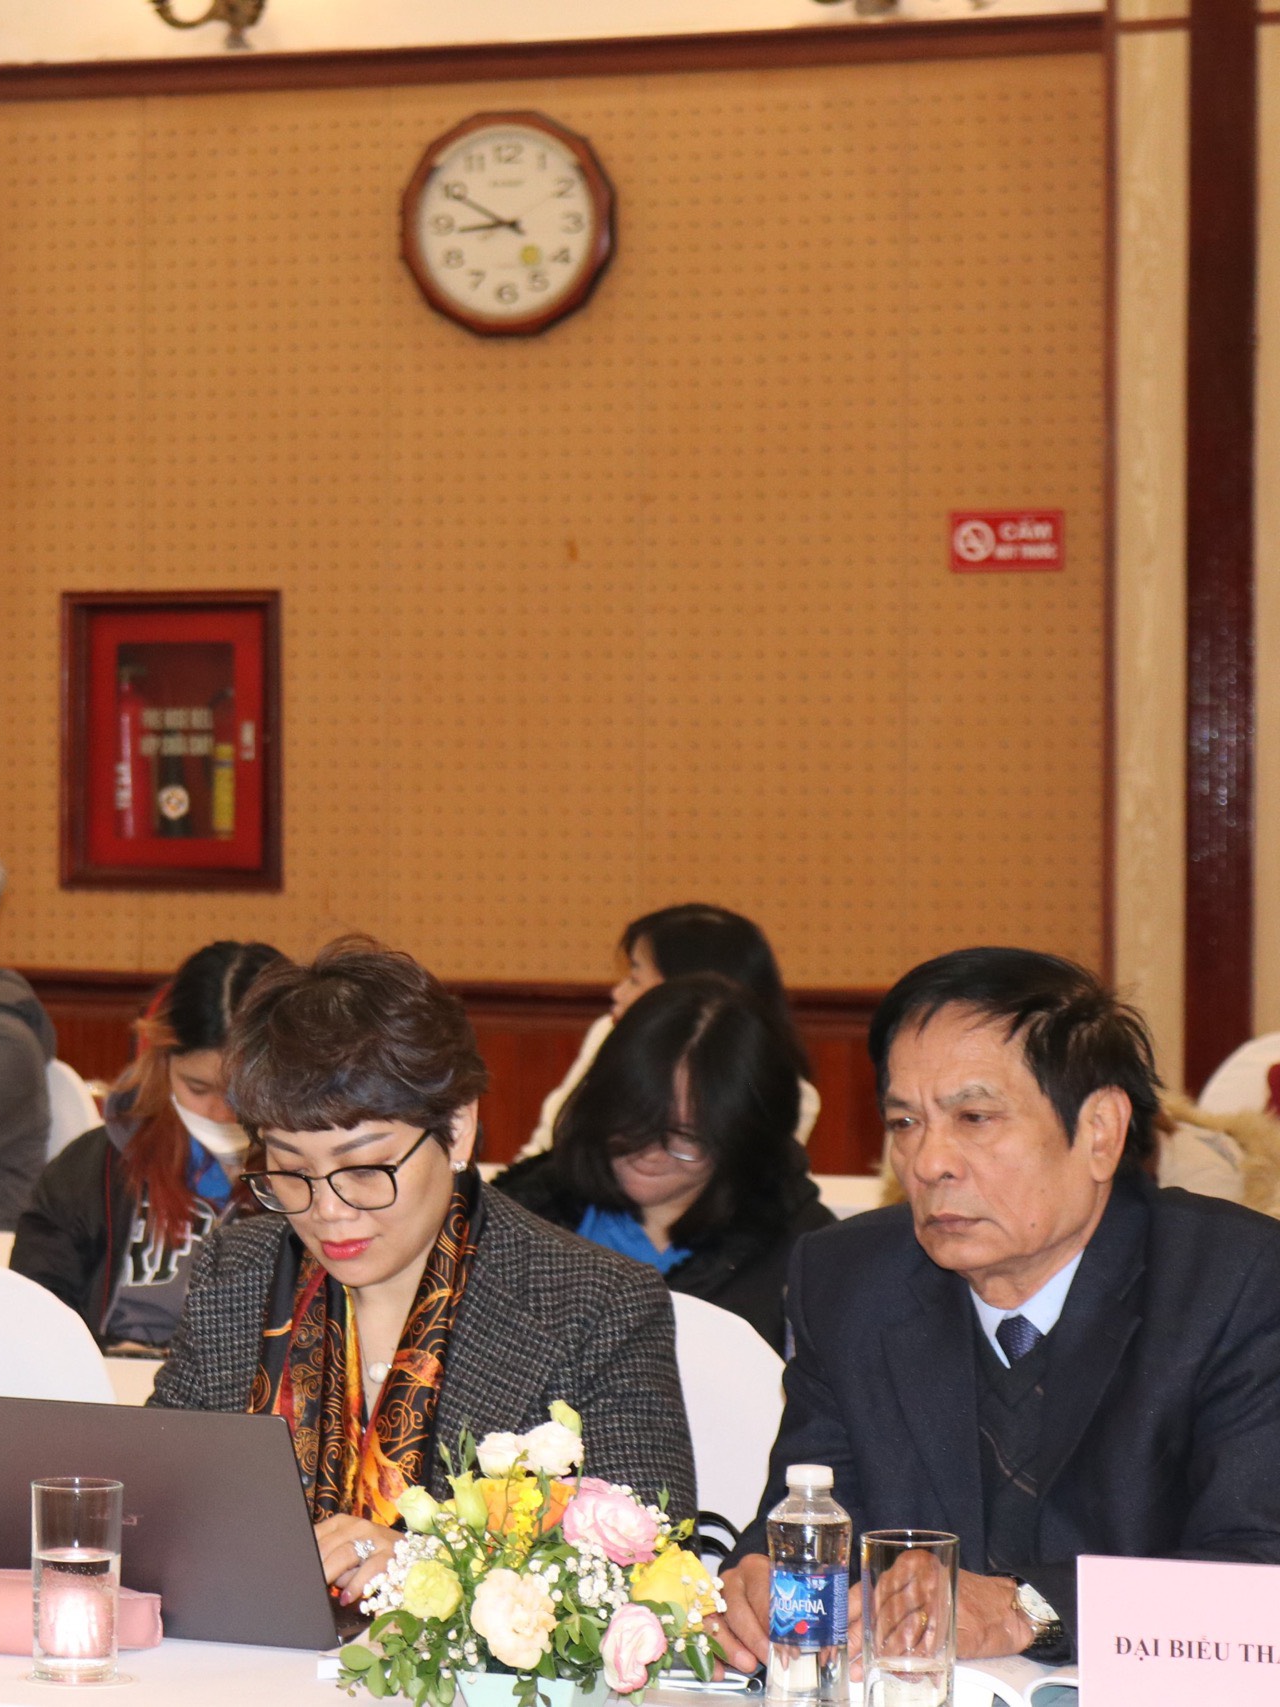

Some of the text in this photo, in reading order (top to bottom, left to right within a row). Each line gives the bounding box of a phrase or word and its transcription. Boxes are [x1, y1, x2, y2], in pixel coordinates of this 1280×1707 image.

[463, 152, 485, 173] 11
[494, 142, 521, 165] 12
[537, 152, 548, 171] 1
[444, 181, 468, 202] 10
[553, 177, 575, 199] 2
[430, 213, 455, 236] 9
[561, 211, 584, 235] 3
[444, 247, 464, 270] 8
[551, 247, 571, 264] 4
[468, 269, 485, 291] 7
[527, 270, 550, 292] 5
[495, 283, 519, 305] 6
[773, 1597, 828, 1617] AQUAFINA
[1114, 1635, 1161, 1662] ĐẠI
